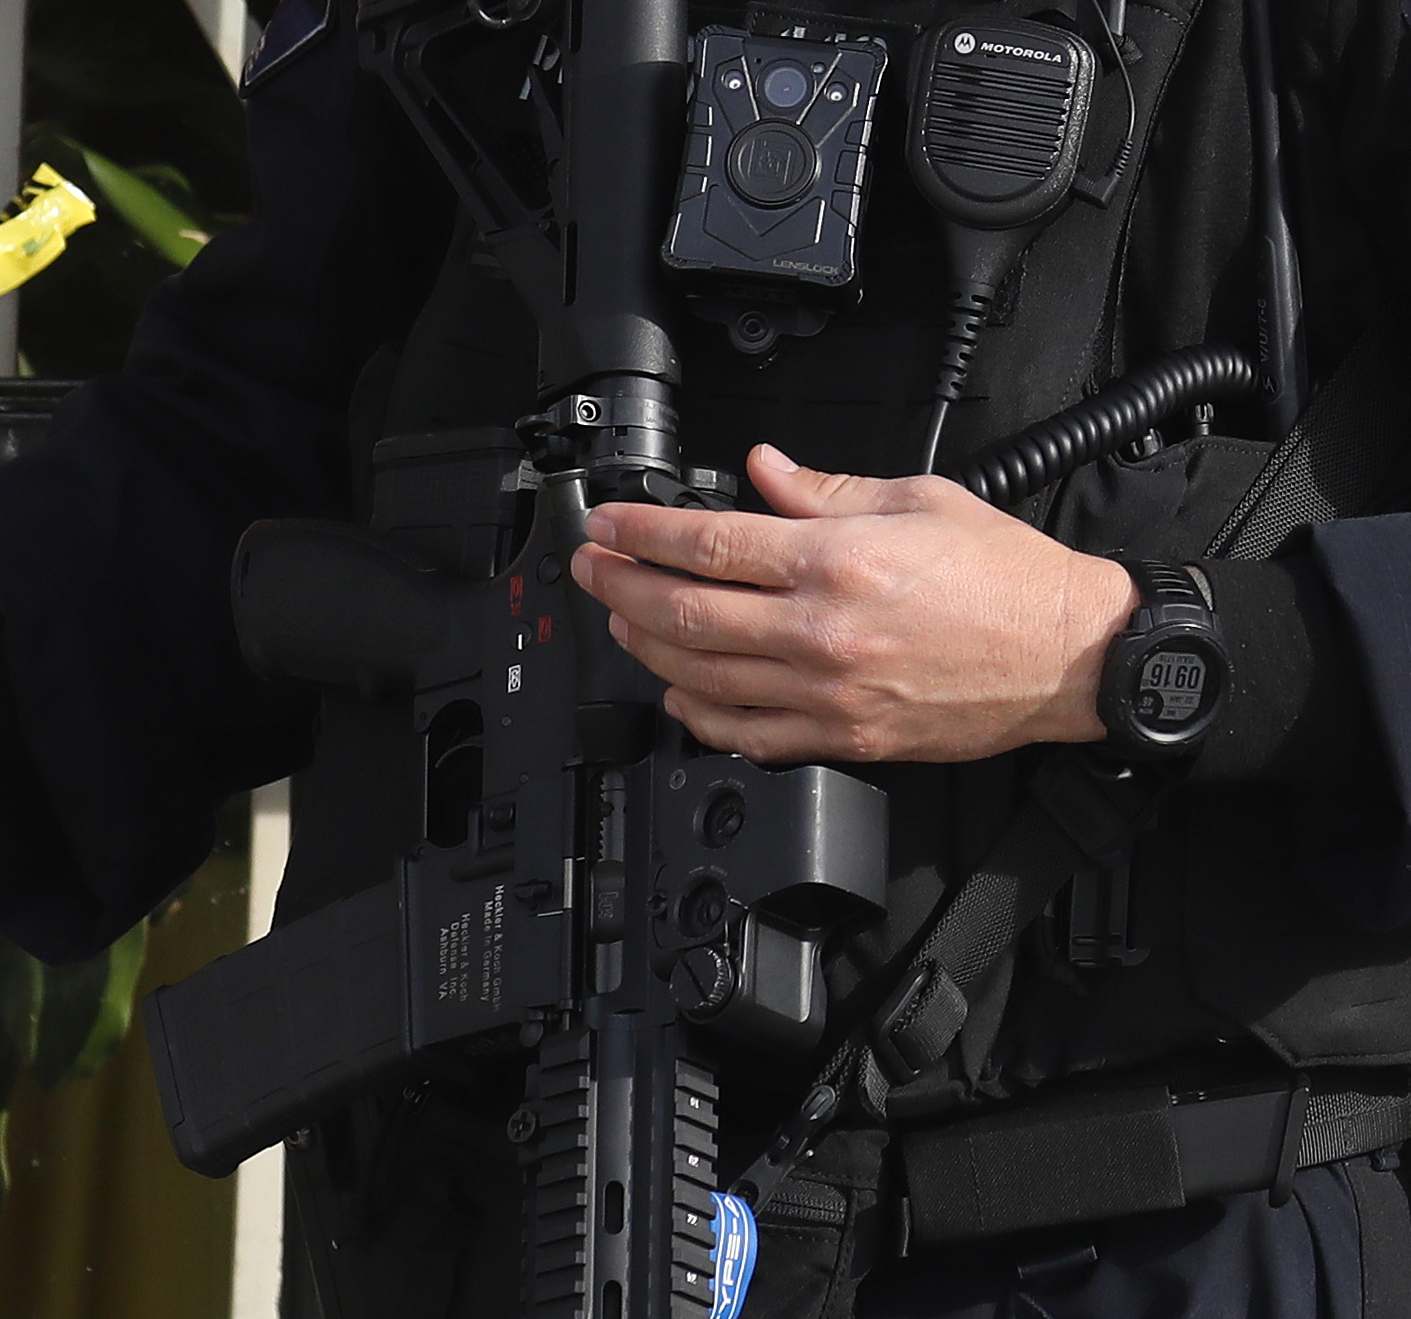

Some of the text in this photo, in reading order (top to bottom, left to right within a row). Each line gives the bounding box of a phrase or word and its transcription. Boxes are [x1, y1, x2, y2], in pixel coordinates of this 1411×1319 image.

[980, 42, 1062, 63] MOTOROLA
[772, 259, 839, 275] LENSLOCK
[1150, 664, 1201, 689] 0916
[482, 899, 494, 933] Made
[437, 927, 450, 1001] Ashburn VA
[448, 921, 459, 1000] Defense Inc.
[459, 912, 471, 1003] Heckler & Koch
[491, 883, 505, 1013] Heckler & Koch GmbH
[480, 950, 492, 1002] Germany
